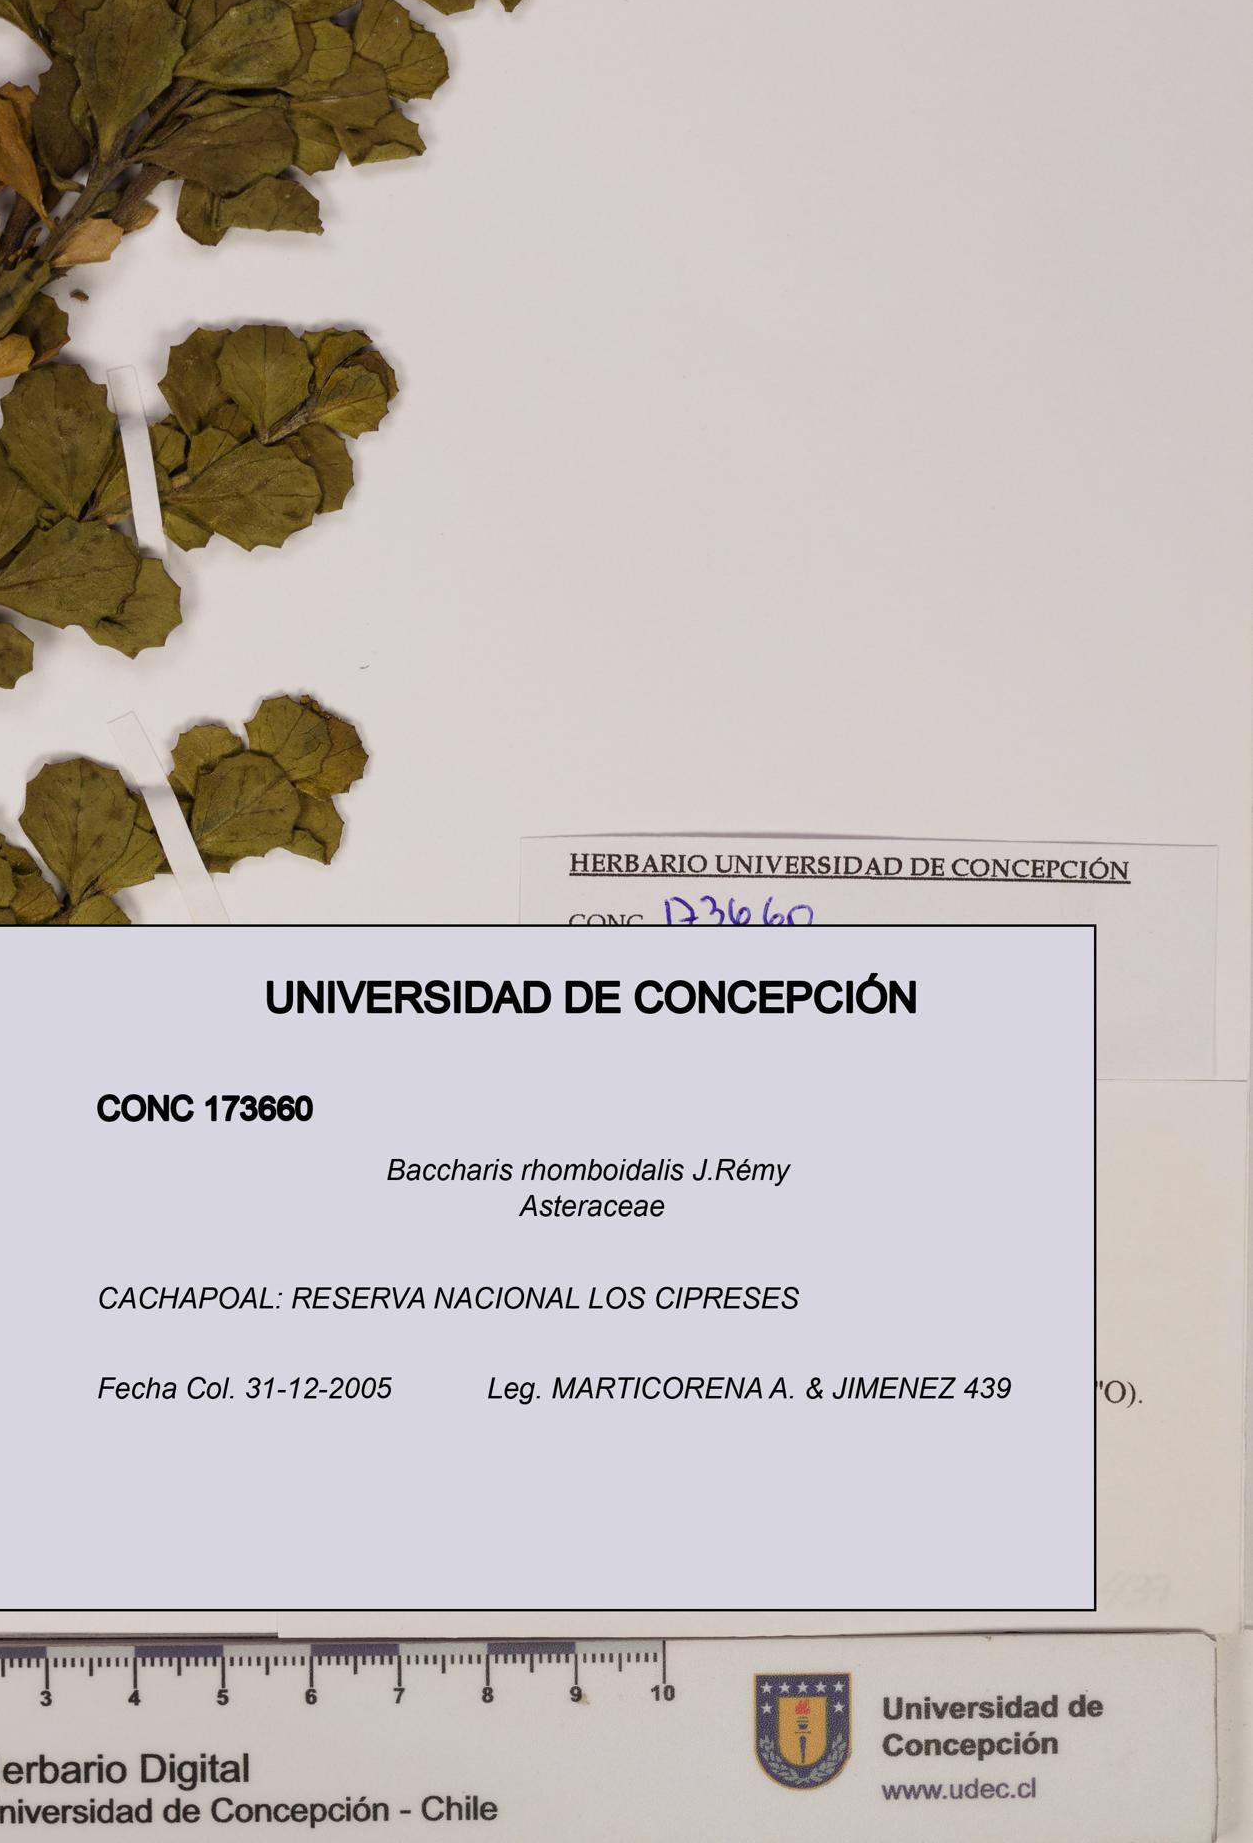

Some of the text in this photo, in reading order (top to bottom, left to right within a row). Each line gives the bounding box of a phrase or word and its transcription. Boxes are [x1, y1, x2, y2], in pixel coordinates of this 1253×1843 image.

[569, 853, 1131, 881] HERBARIO UNIVERSIDAD DE CONCEPCIÓN
[40, 1690, 53, 1707] 3
[127, 1690, 141, 1706] 4
[216, 1689, 229, 1706] 5
[304, 1688, 318, 1705] 6
[393, 1687, 405, 1704] 7
[481, 1687, 494, 1704] 8
[569, 1686, 583, 1703] 9
[650, 1685, 676, 1702] 10
[883, 1694, 1104, 1721] Universidad de
[881, 1730, 1059, 1762] Concepción
[140, 1752, 250, 1792] Digital
[881, 1776, 1037, 1801] www.udec.cl
[162, 1797, 201, 1824] de
[210, 1796, 390, 1829] Concepción
[421, 1795, 499, 1822] Chile
